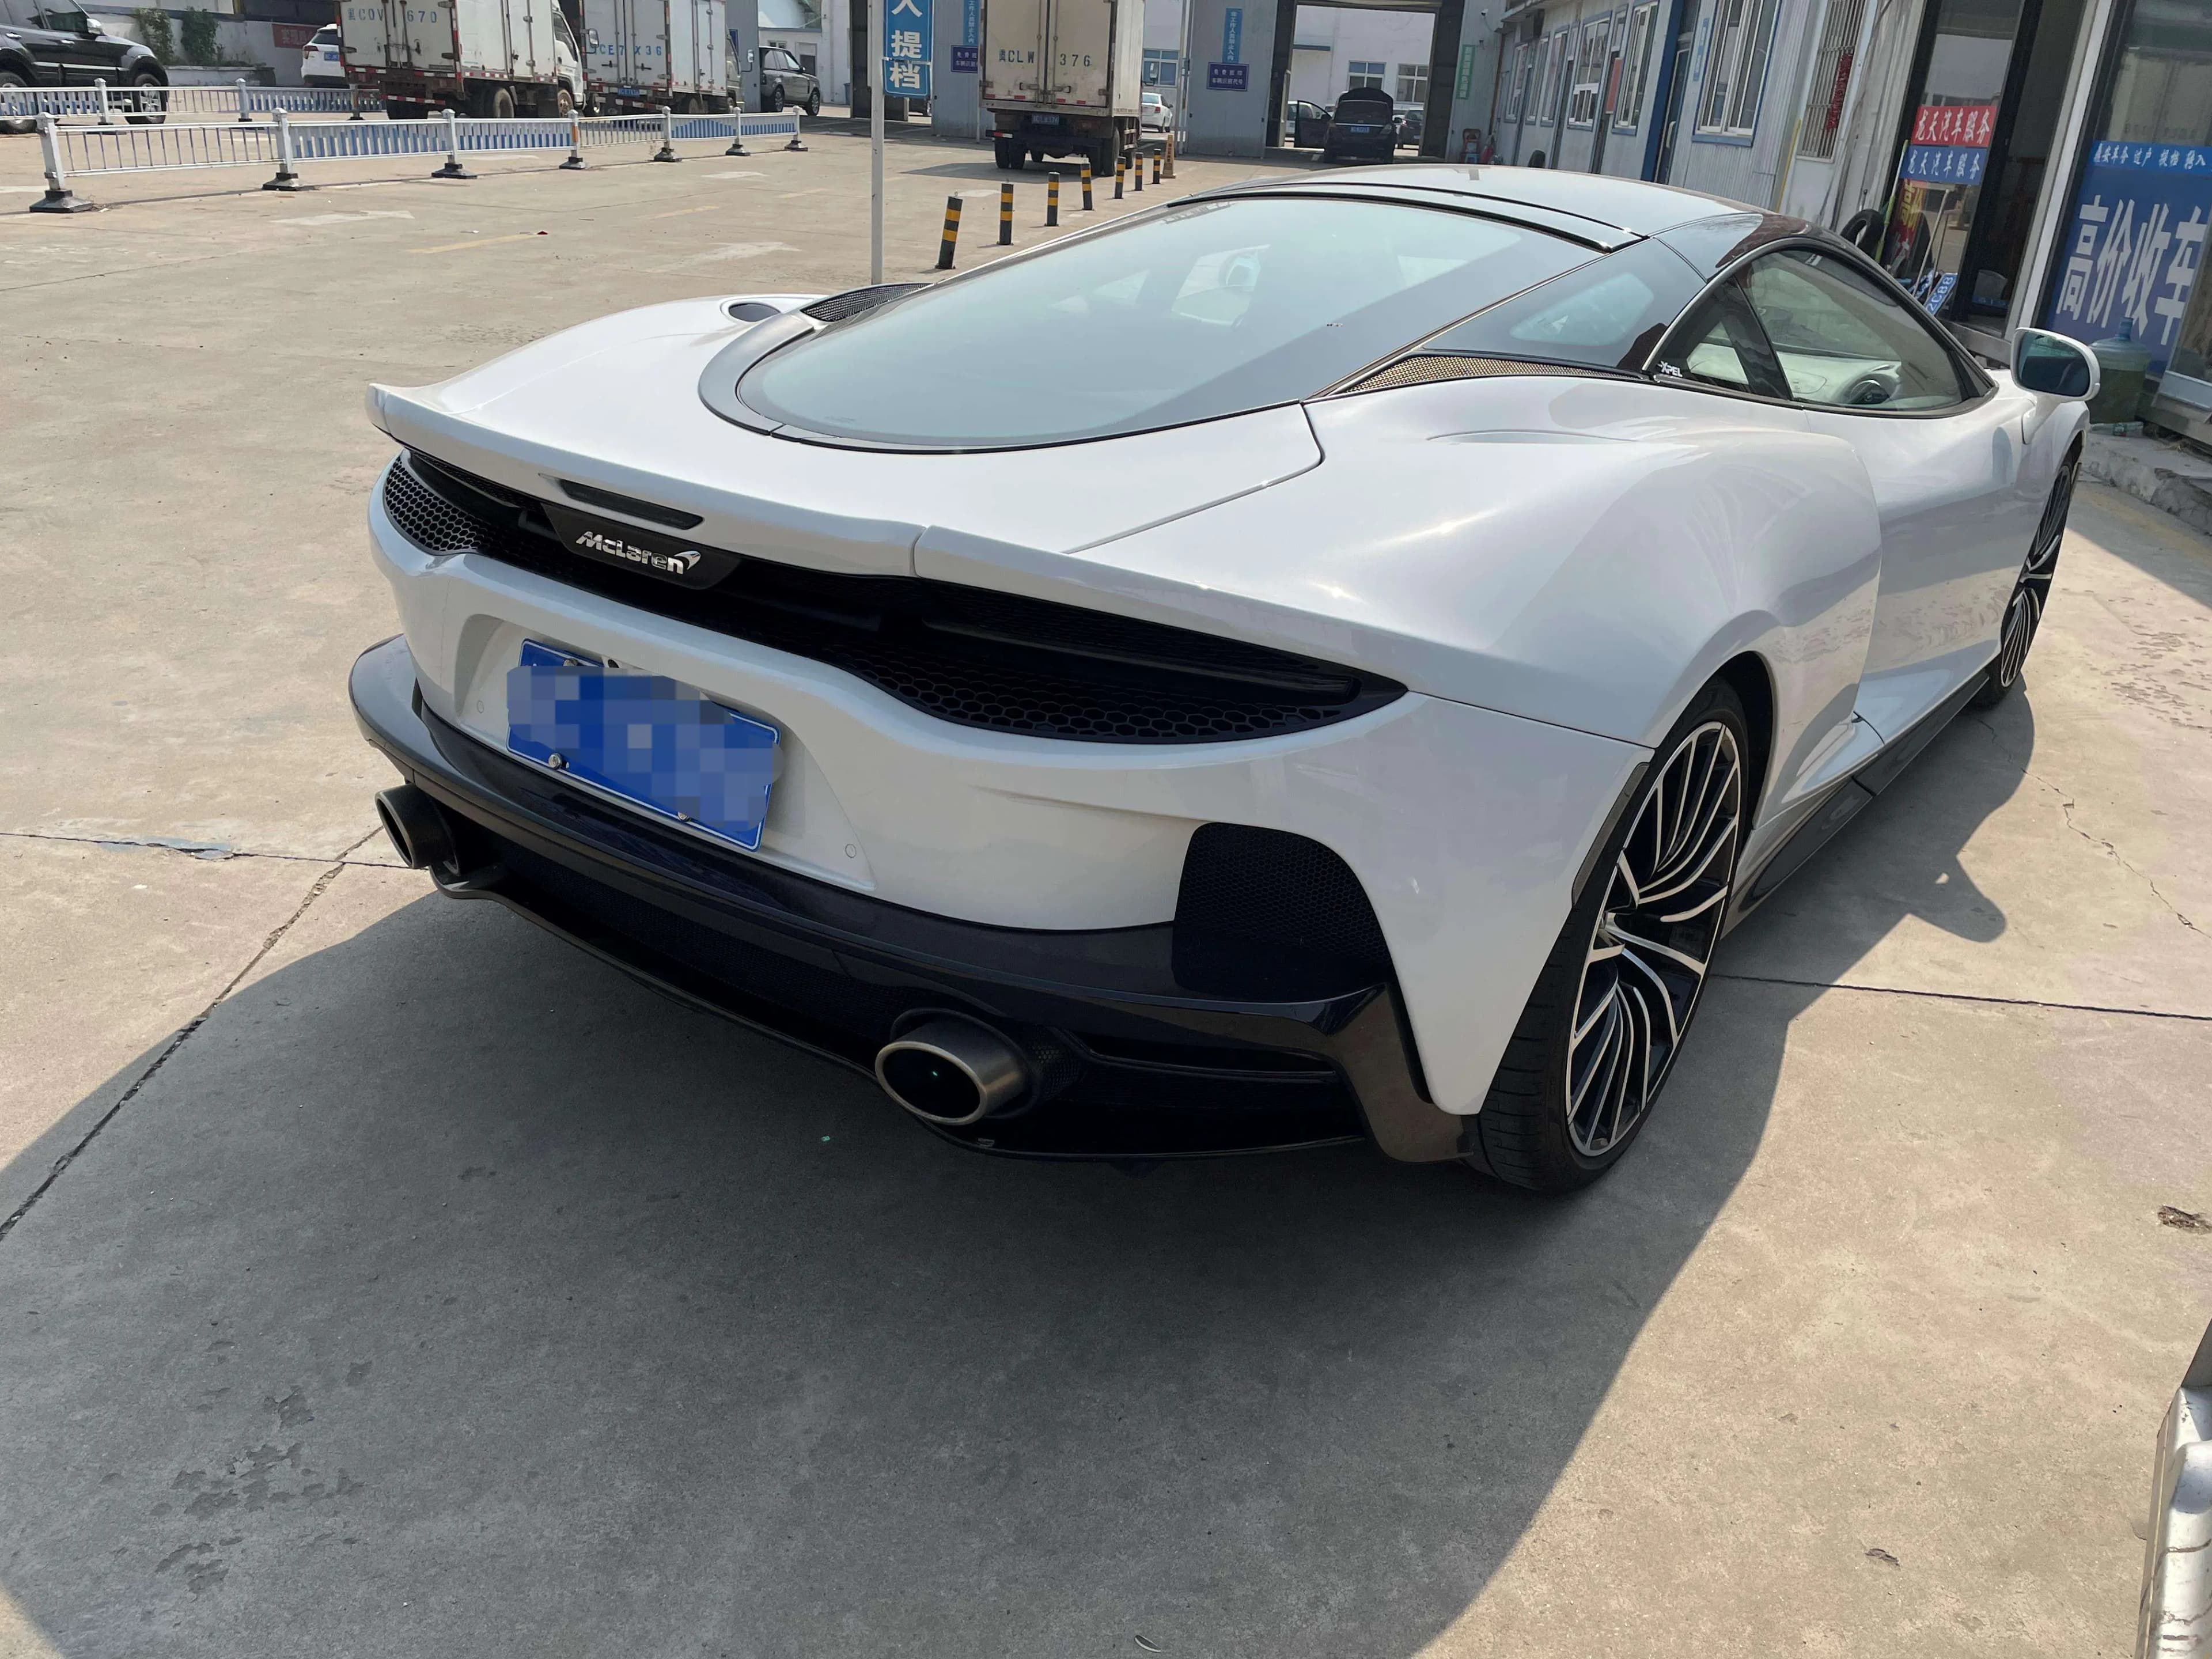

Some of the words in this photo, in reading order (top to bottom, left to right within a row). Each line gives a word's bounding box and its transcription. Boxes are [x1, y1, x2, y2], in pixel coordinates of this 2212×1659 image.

[407, 10, 437, 23] 670
[1059, 53, 1090, 67] 376
[2134, 147, 2152, 167] 过户
[2056, 195, 2207, 346] 高价收车
[1657, 360, 1683, 378] XPEL
[576, 531, 683, 574] McLaren
